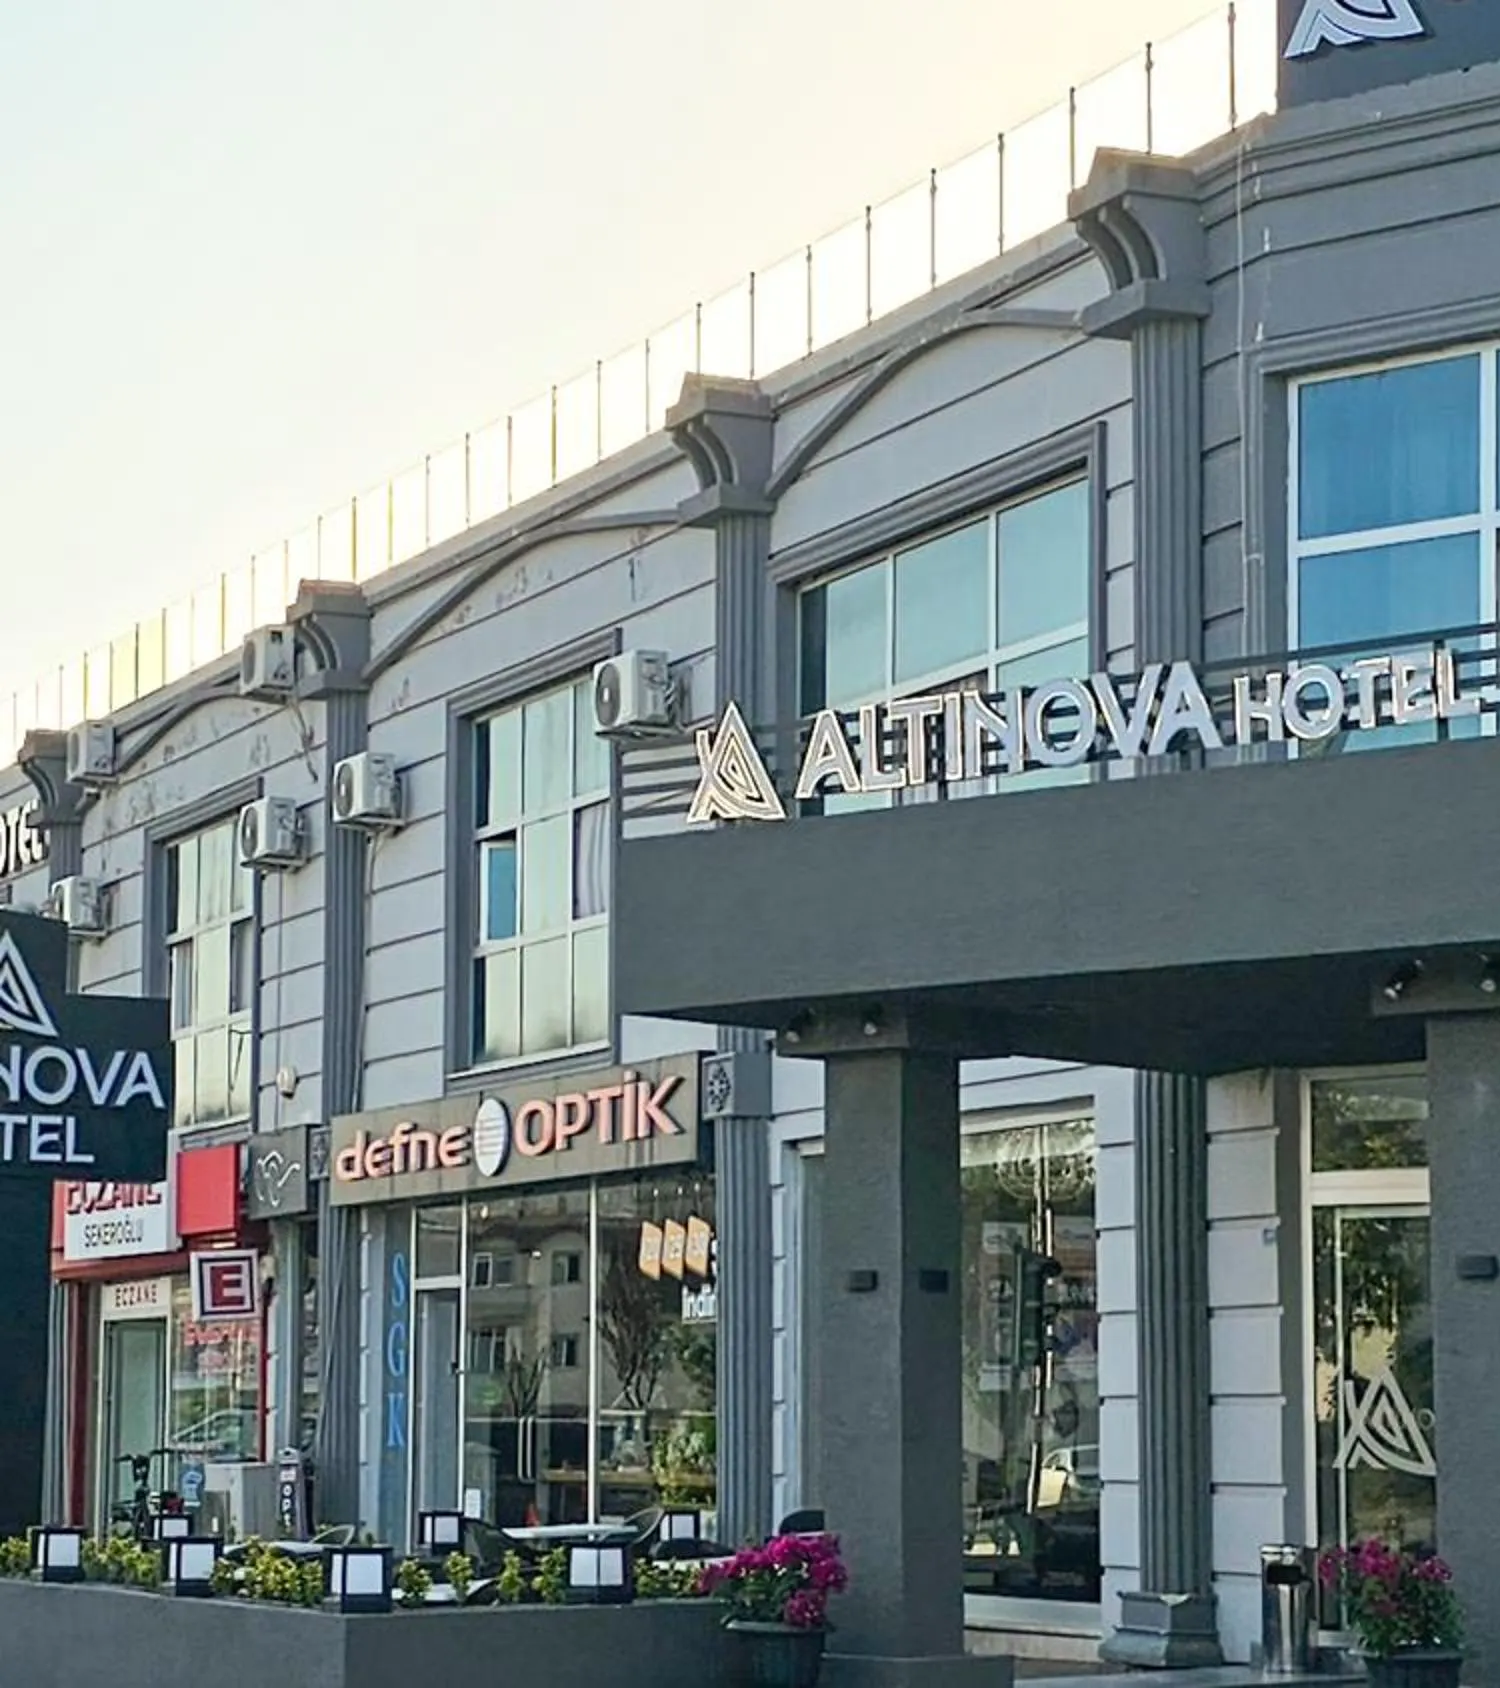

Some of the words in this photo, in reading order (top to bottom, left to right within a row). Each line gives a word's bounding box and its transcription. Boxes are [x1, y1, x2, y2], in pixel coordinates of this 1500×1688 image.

[794, 660, 1223, 799] ALTINOVA
[1233, 649, 1481, 744] HOTEL
[0, 1114, 95, 1163] TEL
[335, 1121, 471, 1181] defne
[514, 1070, 686, 1157] OPTİK
[210, 1264, 245, 1308] E
